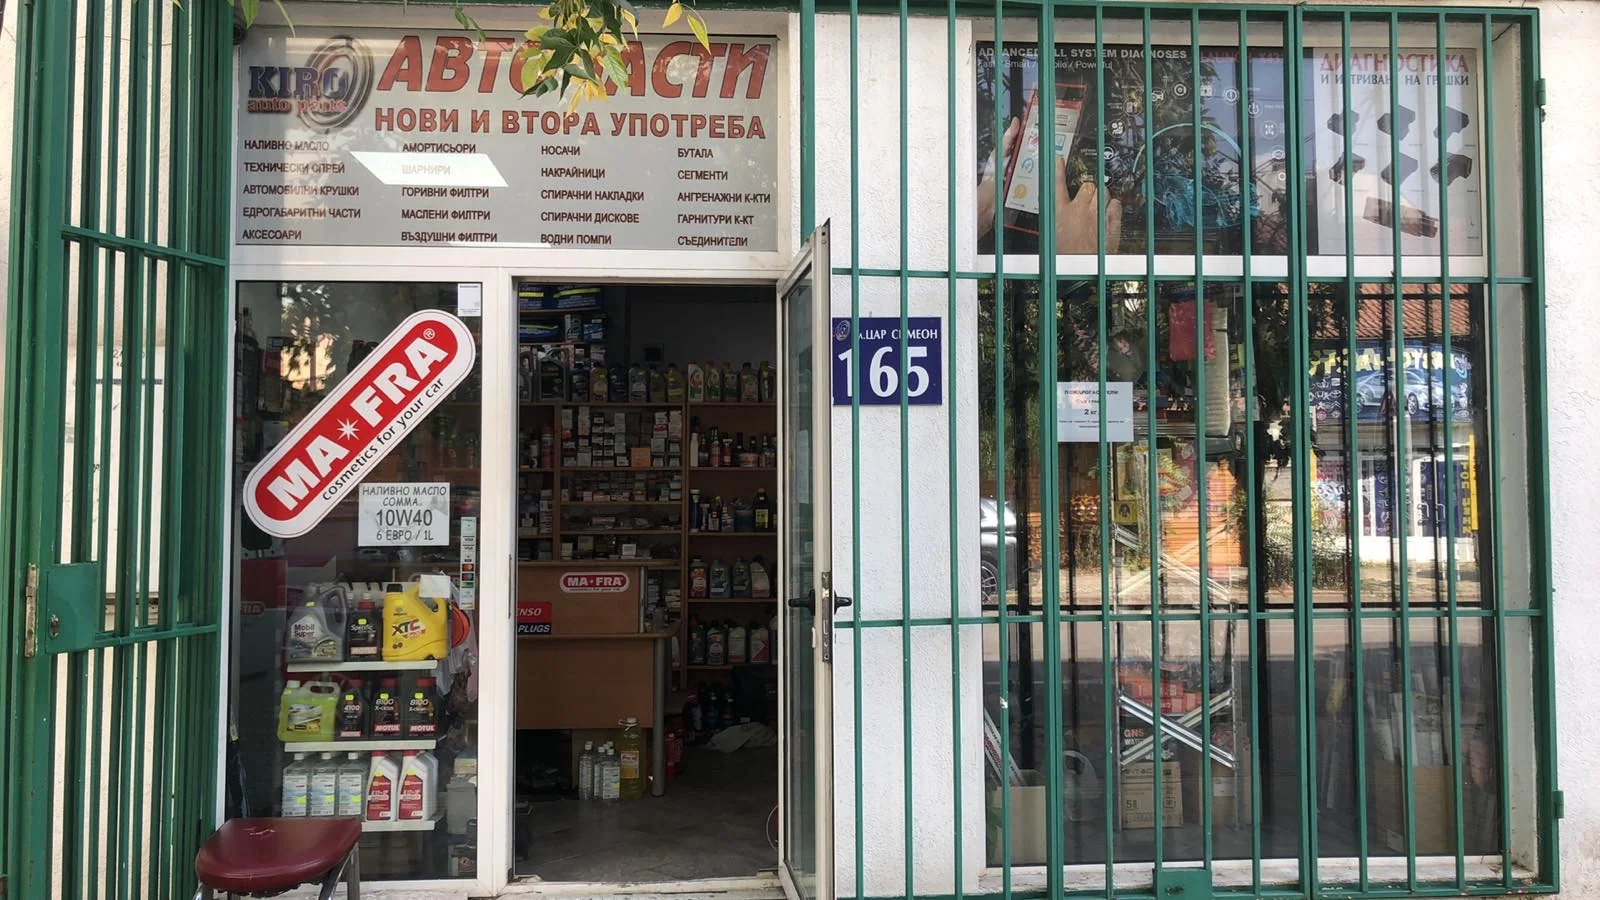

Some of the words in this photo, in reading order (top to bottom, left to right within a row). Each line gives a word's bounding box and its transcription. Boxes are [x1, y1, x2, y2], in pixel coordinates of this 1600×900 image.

[978, 47, 1039, 57] ADANCED
[376, 34, 771, 99] АВТАСТИ
[248, 66, 349, 98] KIRO
[1321, 74, 1329, 84] И
[1335, 74, 1391, 85] ИТРИВАН
[1405, 75, 1421, 85] НА
[1427, 75, 1469, 86] ГРШКИ
[247, 98, 292, 113] auto
[375, 107, 459, 132] НОВИ
[471, 109, 490, 133] И
[502, 111, 601, 136] ВТОРА
[610, 113, 766, 139] УПОТРЕБА
[244, 140, 292, 150] НАЛИВНО
[294, 141, 330, 151] МАСЛО
[402, 143, 476, 153] АМОРТИСЬОРИ
[541, 145, 581, 156] НОСАЧИ
[677, 148, 714, 159] БУТАЛА
[244, 162, 309, 173] ТЕХНИЧЕСКИ
[311, 161, 345, 174] СПРЕЙ
[402, 164, 451, 175] ШАРНИРИ
[541, 166, 606, 180] НАКРАЙНИЦИ
[677, 170, 728, 181] СЕГМЕНТИ
[243, 185, 317, 196] АВТОМОБИЛНИ
[320, 186, 360, 197] КРУШКИ
[402, 187, 448, 198] ГОРИВНИ
[449, 187, 490, 198] ФИЛТРИ
[541, 190, 593, 201] СПИРАЧНИ
[594, 191, 644, 202] НАКЛАДКИ
[677, 192, 742, 203] АНГРЕНАЖНИ
[744, 193, 771, 204] К-КТИ
[242, 207, 326, 219] ЕДРОГАБАРИТНИ
[329, 208, 361, 219] ЧАСТИ
[401, 210, 449, 220] МАСЛЕНИ
[451, 210, 491, 221] ФИЛТРИ
[541, 212, 593, 223] СПИРАЧНИ
[594, 213, 640, 224] ДИСКОВЕ
[677, 214, 732, 225] ГАРНИТУРИ
[734, 215, 754, 225] К-КТ
[242, 230, 302, 240] АКСЕСОАРИ
[401, 231, 455, 243] ВЪЗДУШНИ
[457, 232, 498, 243] ФИЛТРИ
[541, 234, 575, 245] ВОДНИ
[576, 234, 612, 245] ПОМПИ
[677, 235, 748, 247] СЪЕДИНИТЕЛИ
[891, 329, 938, 340] СМЕОН
[838, 346, 930, 398] 165
[323, 446, 378, 501] cosmetics
[377, 427, 396, 446] for
[397, 398, 424, 429] your
[425, 378, 444, 398] car
[362, 486, 410, 496] НАЛИВНО
[412, 486, 447, 496] МАСЛО
[376, 509, 433, 527] 10W40
[376, 530, 383, 541] 6
[386, 530, 412, 541] ЕВРО
[516, 608, 542, 616] ENSO
[518, 624, 551, 633] PLUGS
